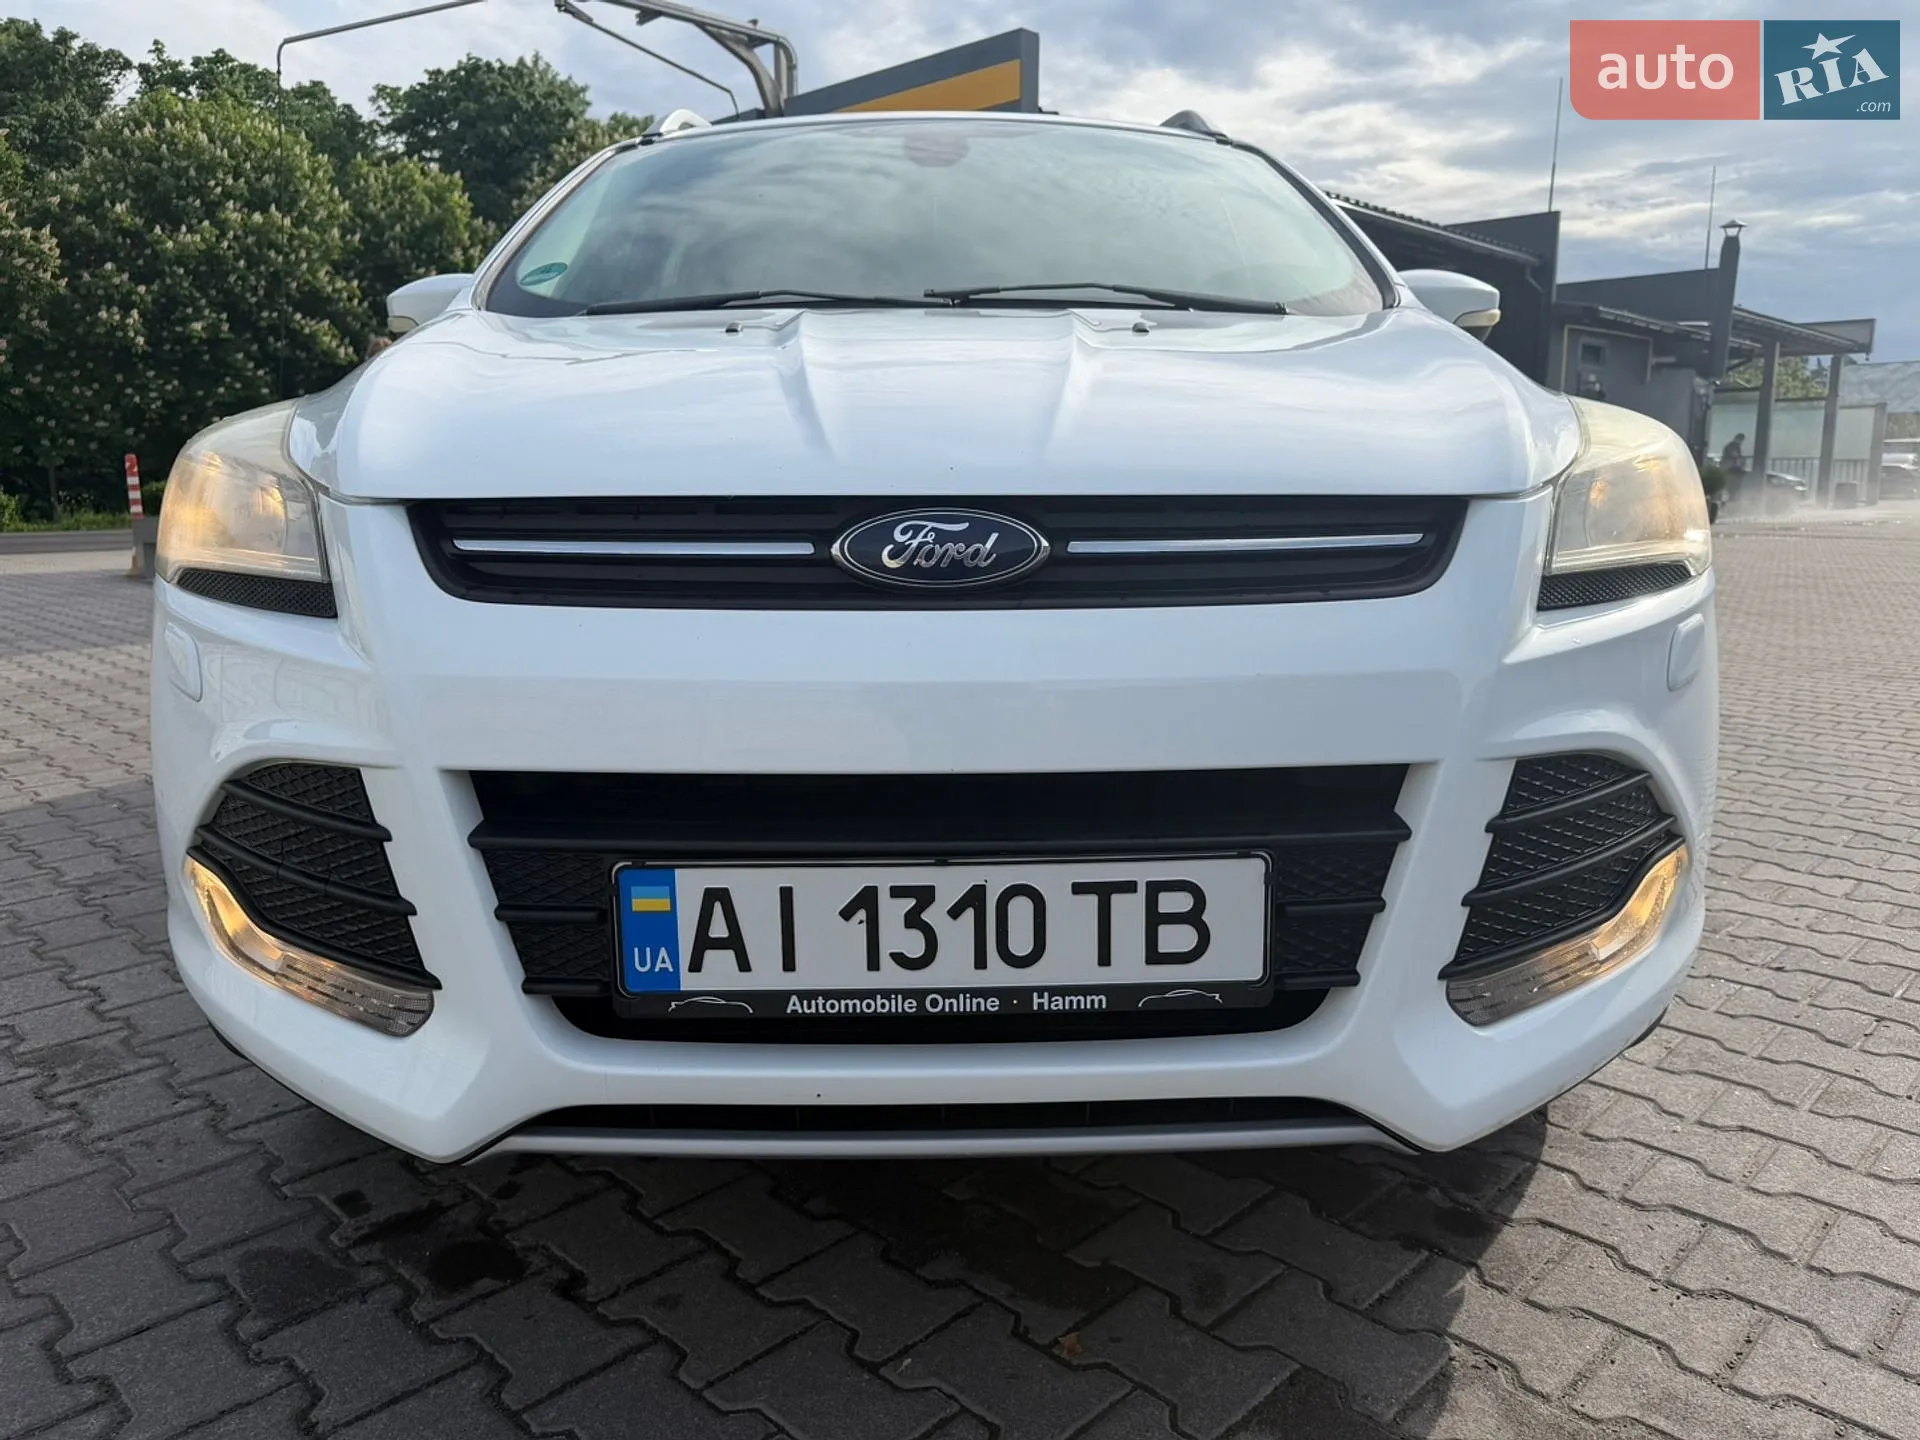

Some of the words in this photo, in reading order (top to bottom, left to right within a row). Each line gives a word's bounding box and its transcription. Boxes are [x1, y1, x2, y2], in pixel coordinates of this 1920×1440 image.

[881, 520, 999, 568] Ford
[687, 886, 796, 973] AI
[838, 882, 1047, 972] 1310
[1071, 878, 1211, 967] TB
[633, 947, 674, 973] UA
[786, 994, 918, 1016] Automobile
[924, 993, 1000, 1013] Online
[1032, 991, 1107, 1011] Hamm
